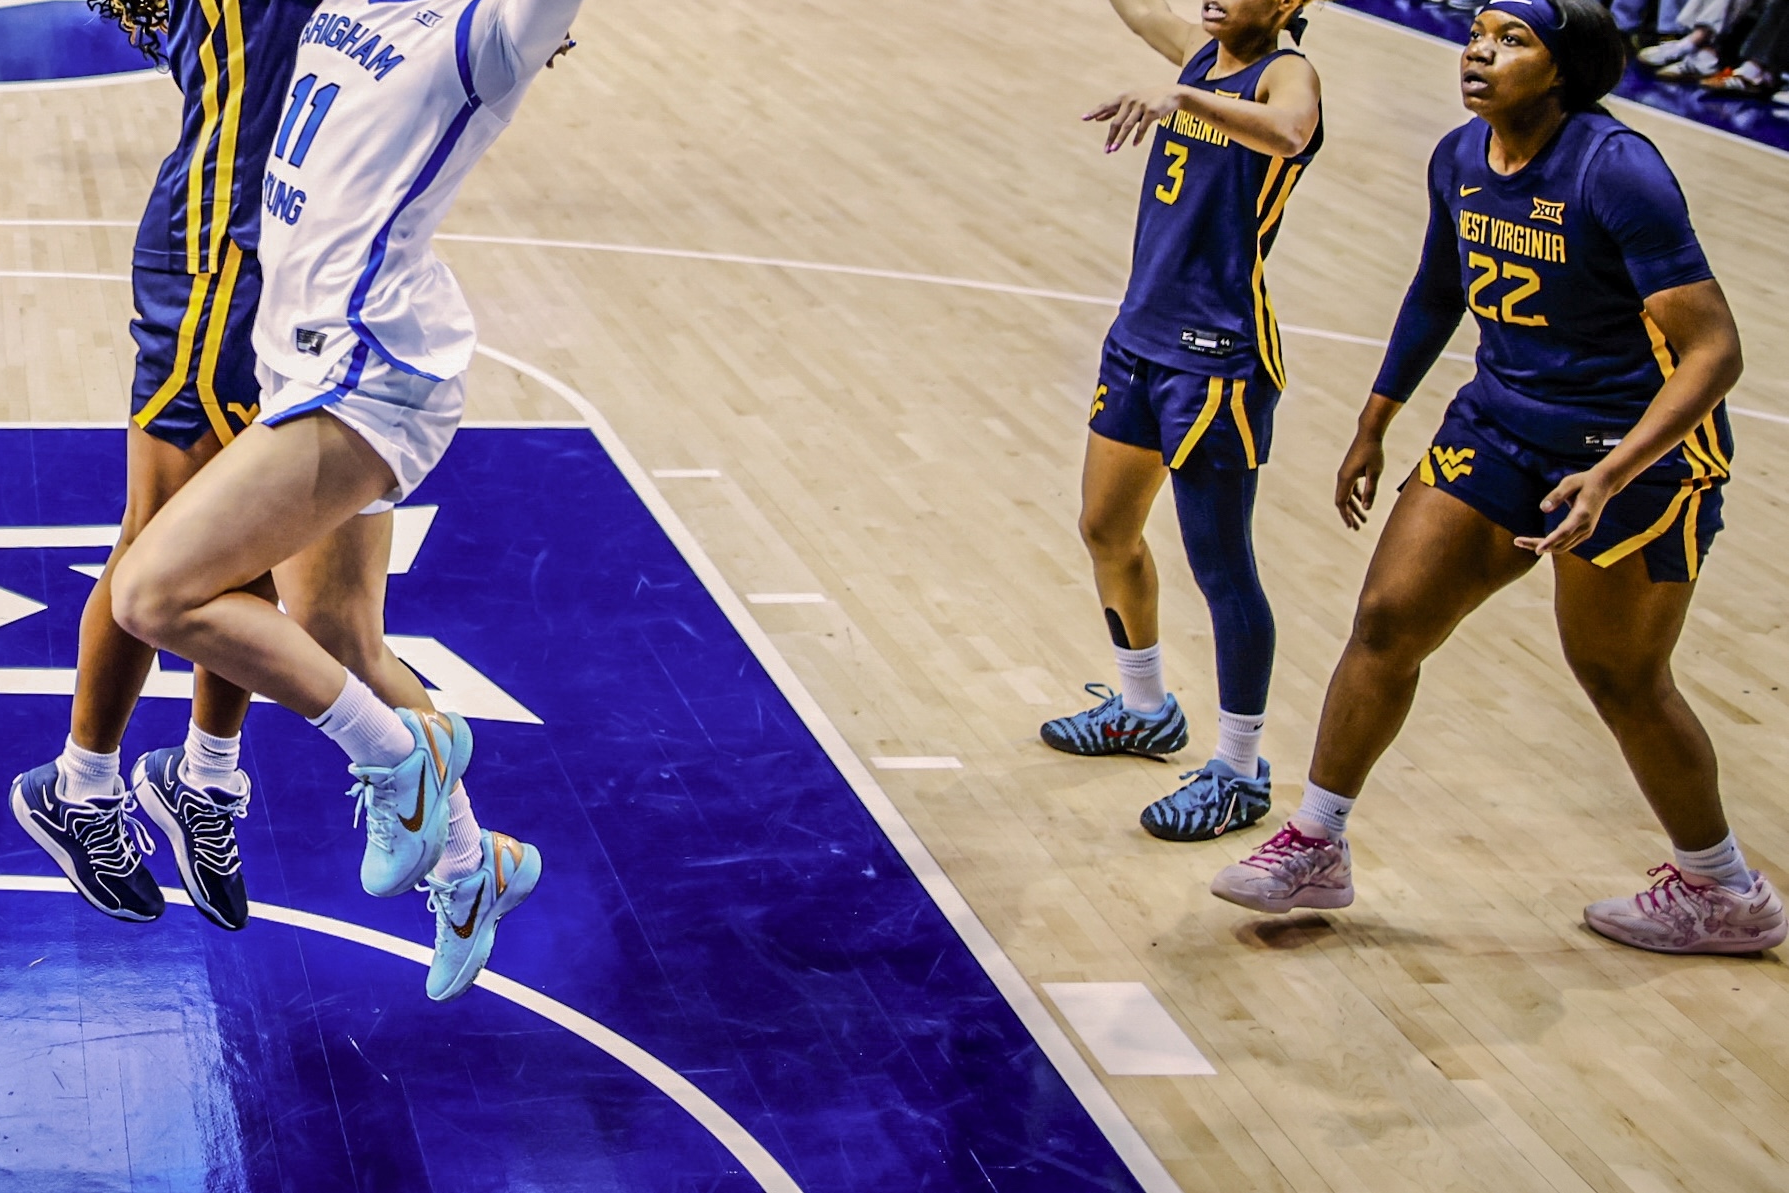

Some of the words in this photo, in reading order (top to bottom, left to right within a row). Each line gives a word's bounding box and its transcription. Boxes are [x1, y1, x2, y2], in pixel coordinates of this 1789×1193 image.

[274, 72, 341, 169] 11
[1155, 140, 1189, 206] 3
[1459, 209, 1489, 245] WEST
[1490, 217, 1566, 264] VIRGINIA
[1468, 250, 1550, 327] 22
